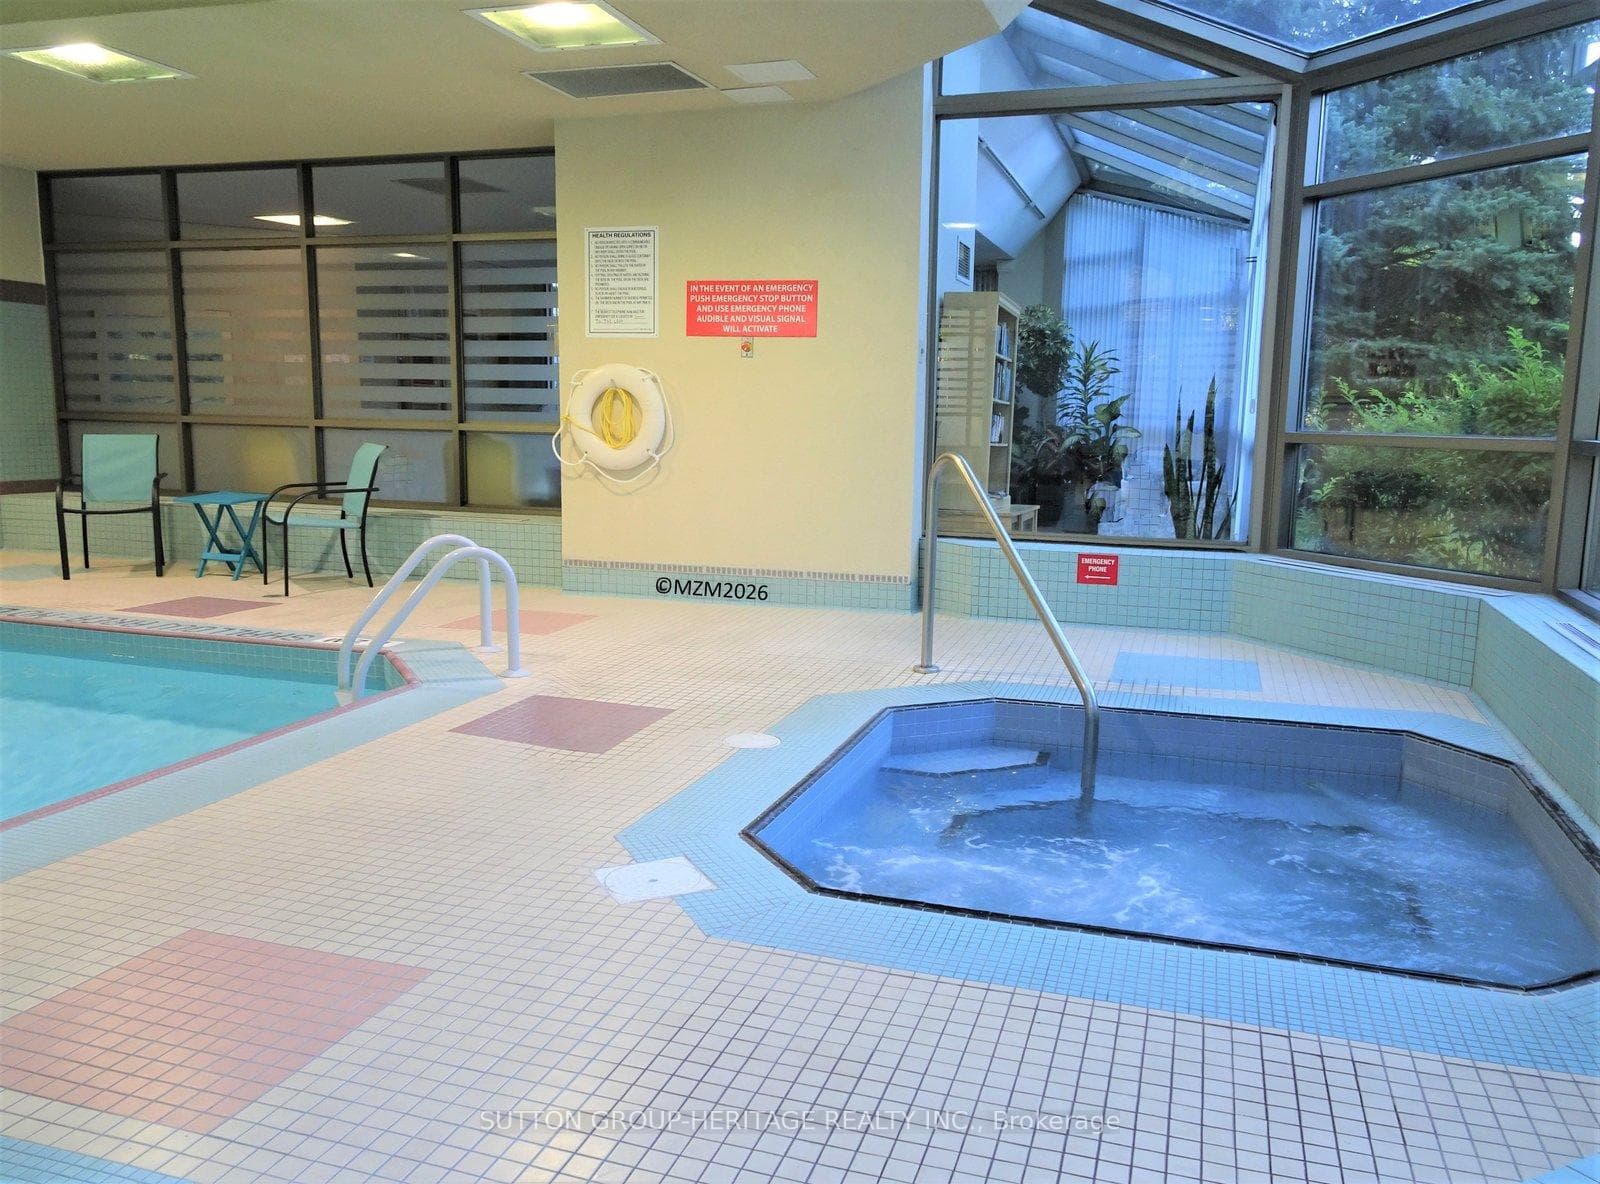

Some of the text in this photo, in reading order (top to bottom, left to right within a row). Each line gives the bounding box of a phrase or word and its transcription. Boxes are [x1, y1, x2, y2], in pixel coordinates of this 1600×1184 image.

[690, 284, 814, 293] IN THE EVENT OF AN EMERGENCY
[690, 294, 813, 303] PUSH EMERGENCY STOP BUTTON
[696, 305, 806, 313] AND USE EMERGENCY PHONE
[696, 315, 806, 323] AUDIBLE AND VISUAL SIGNAL
[722, 325, 778, 333] WILL ACTIVATE
